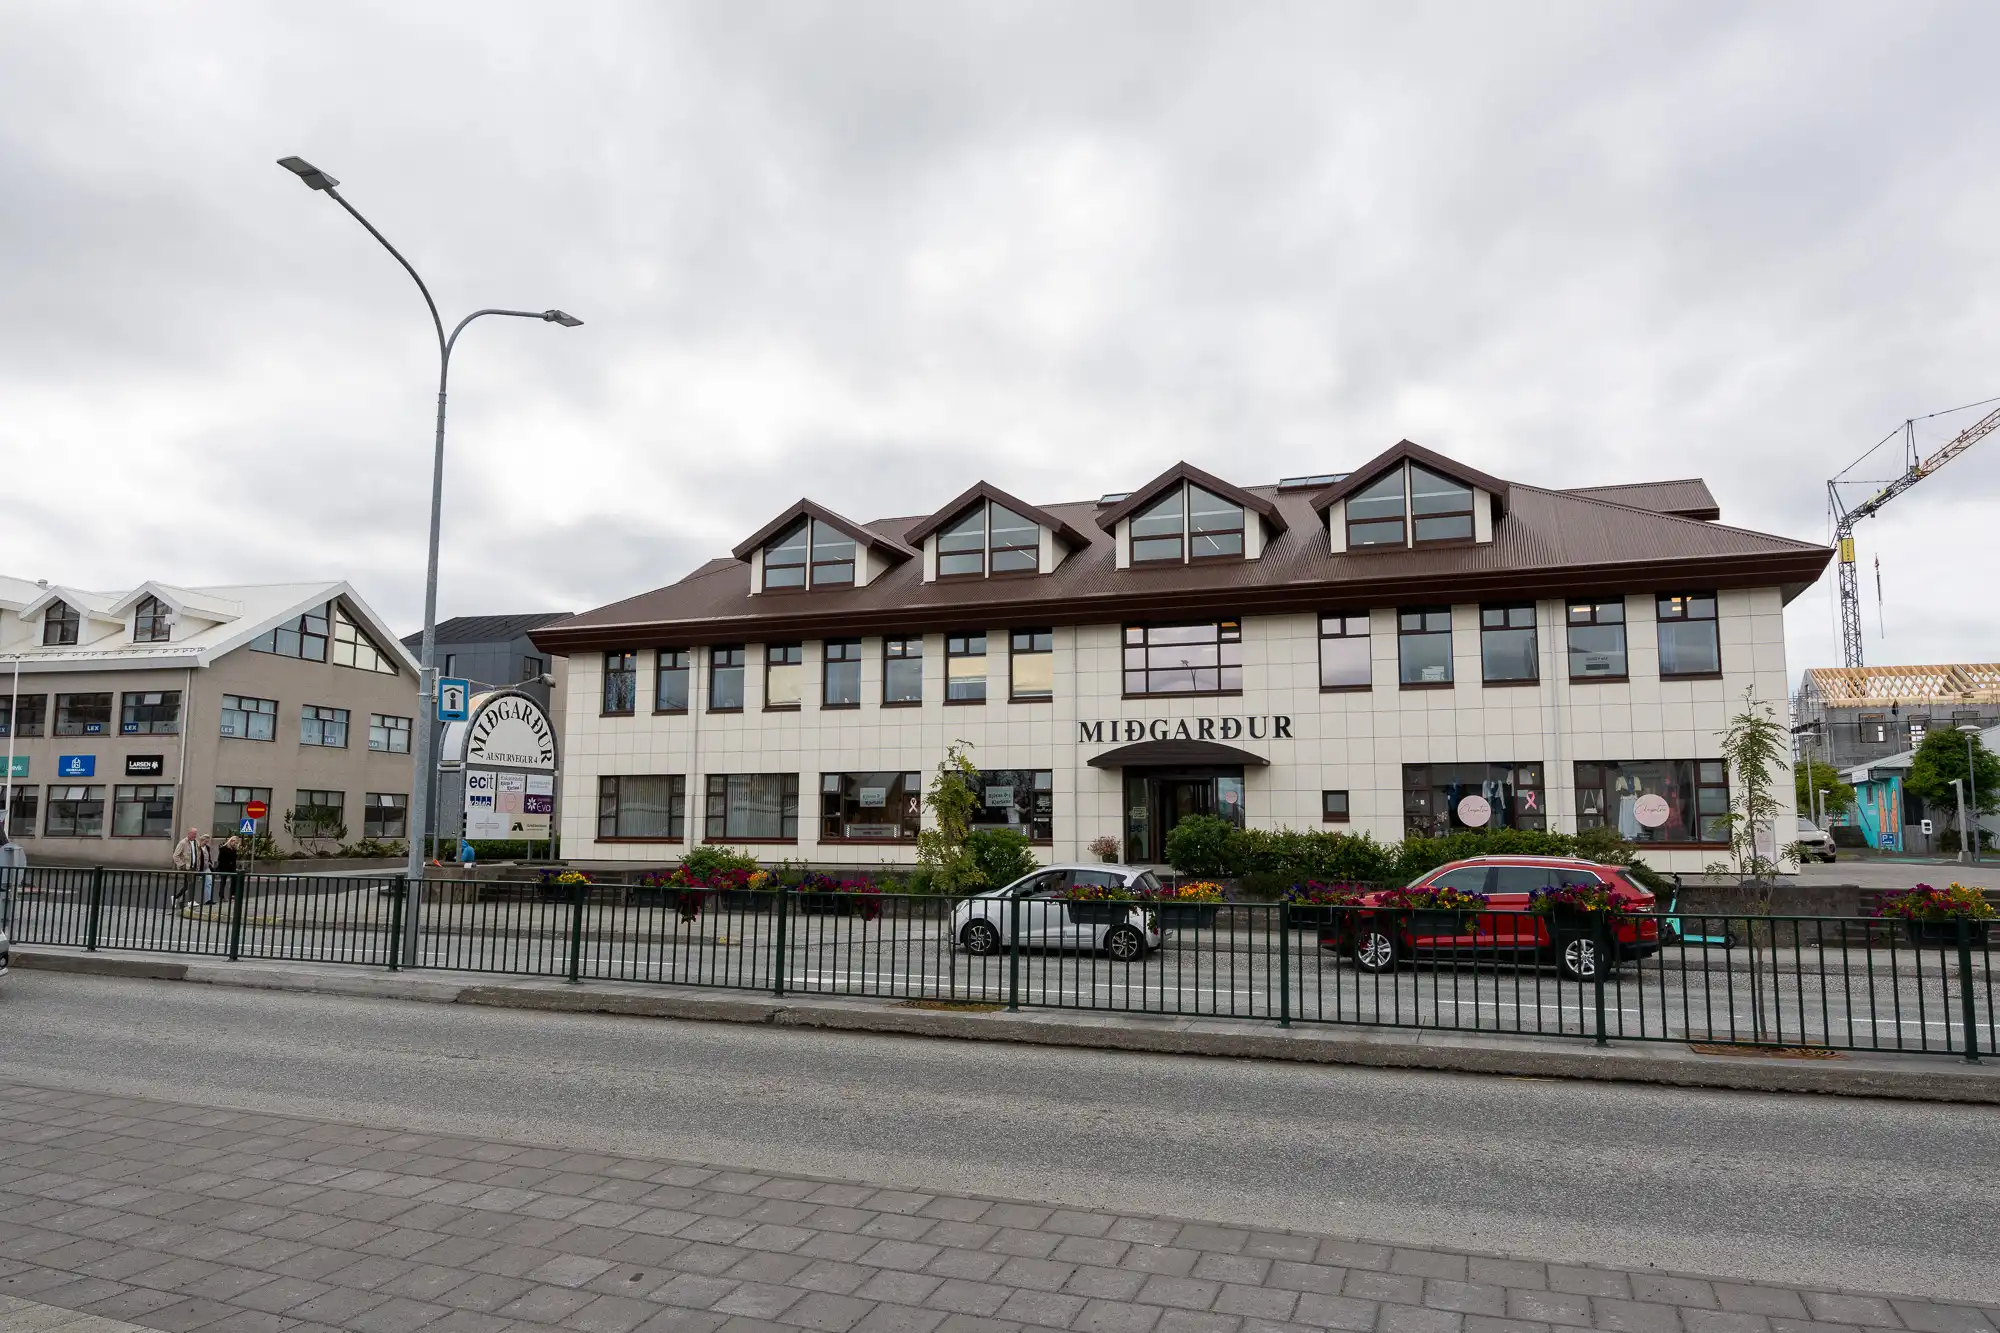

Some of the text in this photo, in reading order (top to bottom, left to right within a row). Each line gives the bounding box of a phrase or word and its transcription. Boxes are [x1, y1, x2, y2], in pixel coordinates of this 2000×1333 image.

[470, 700, 552, 764] MIÐGARÐUR
[1078, 715, 1293, 742] MIÐGARÐUR
[486, 751, 538, 764] AUSTURVEGUR 4
[469, 773, 494, 790] ecit
[537, 802, 552, 812] Eva
